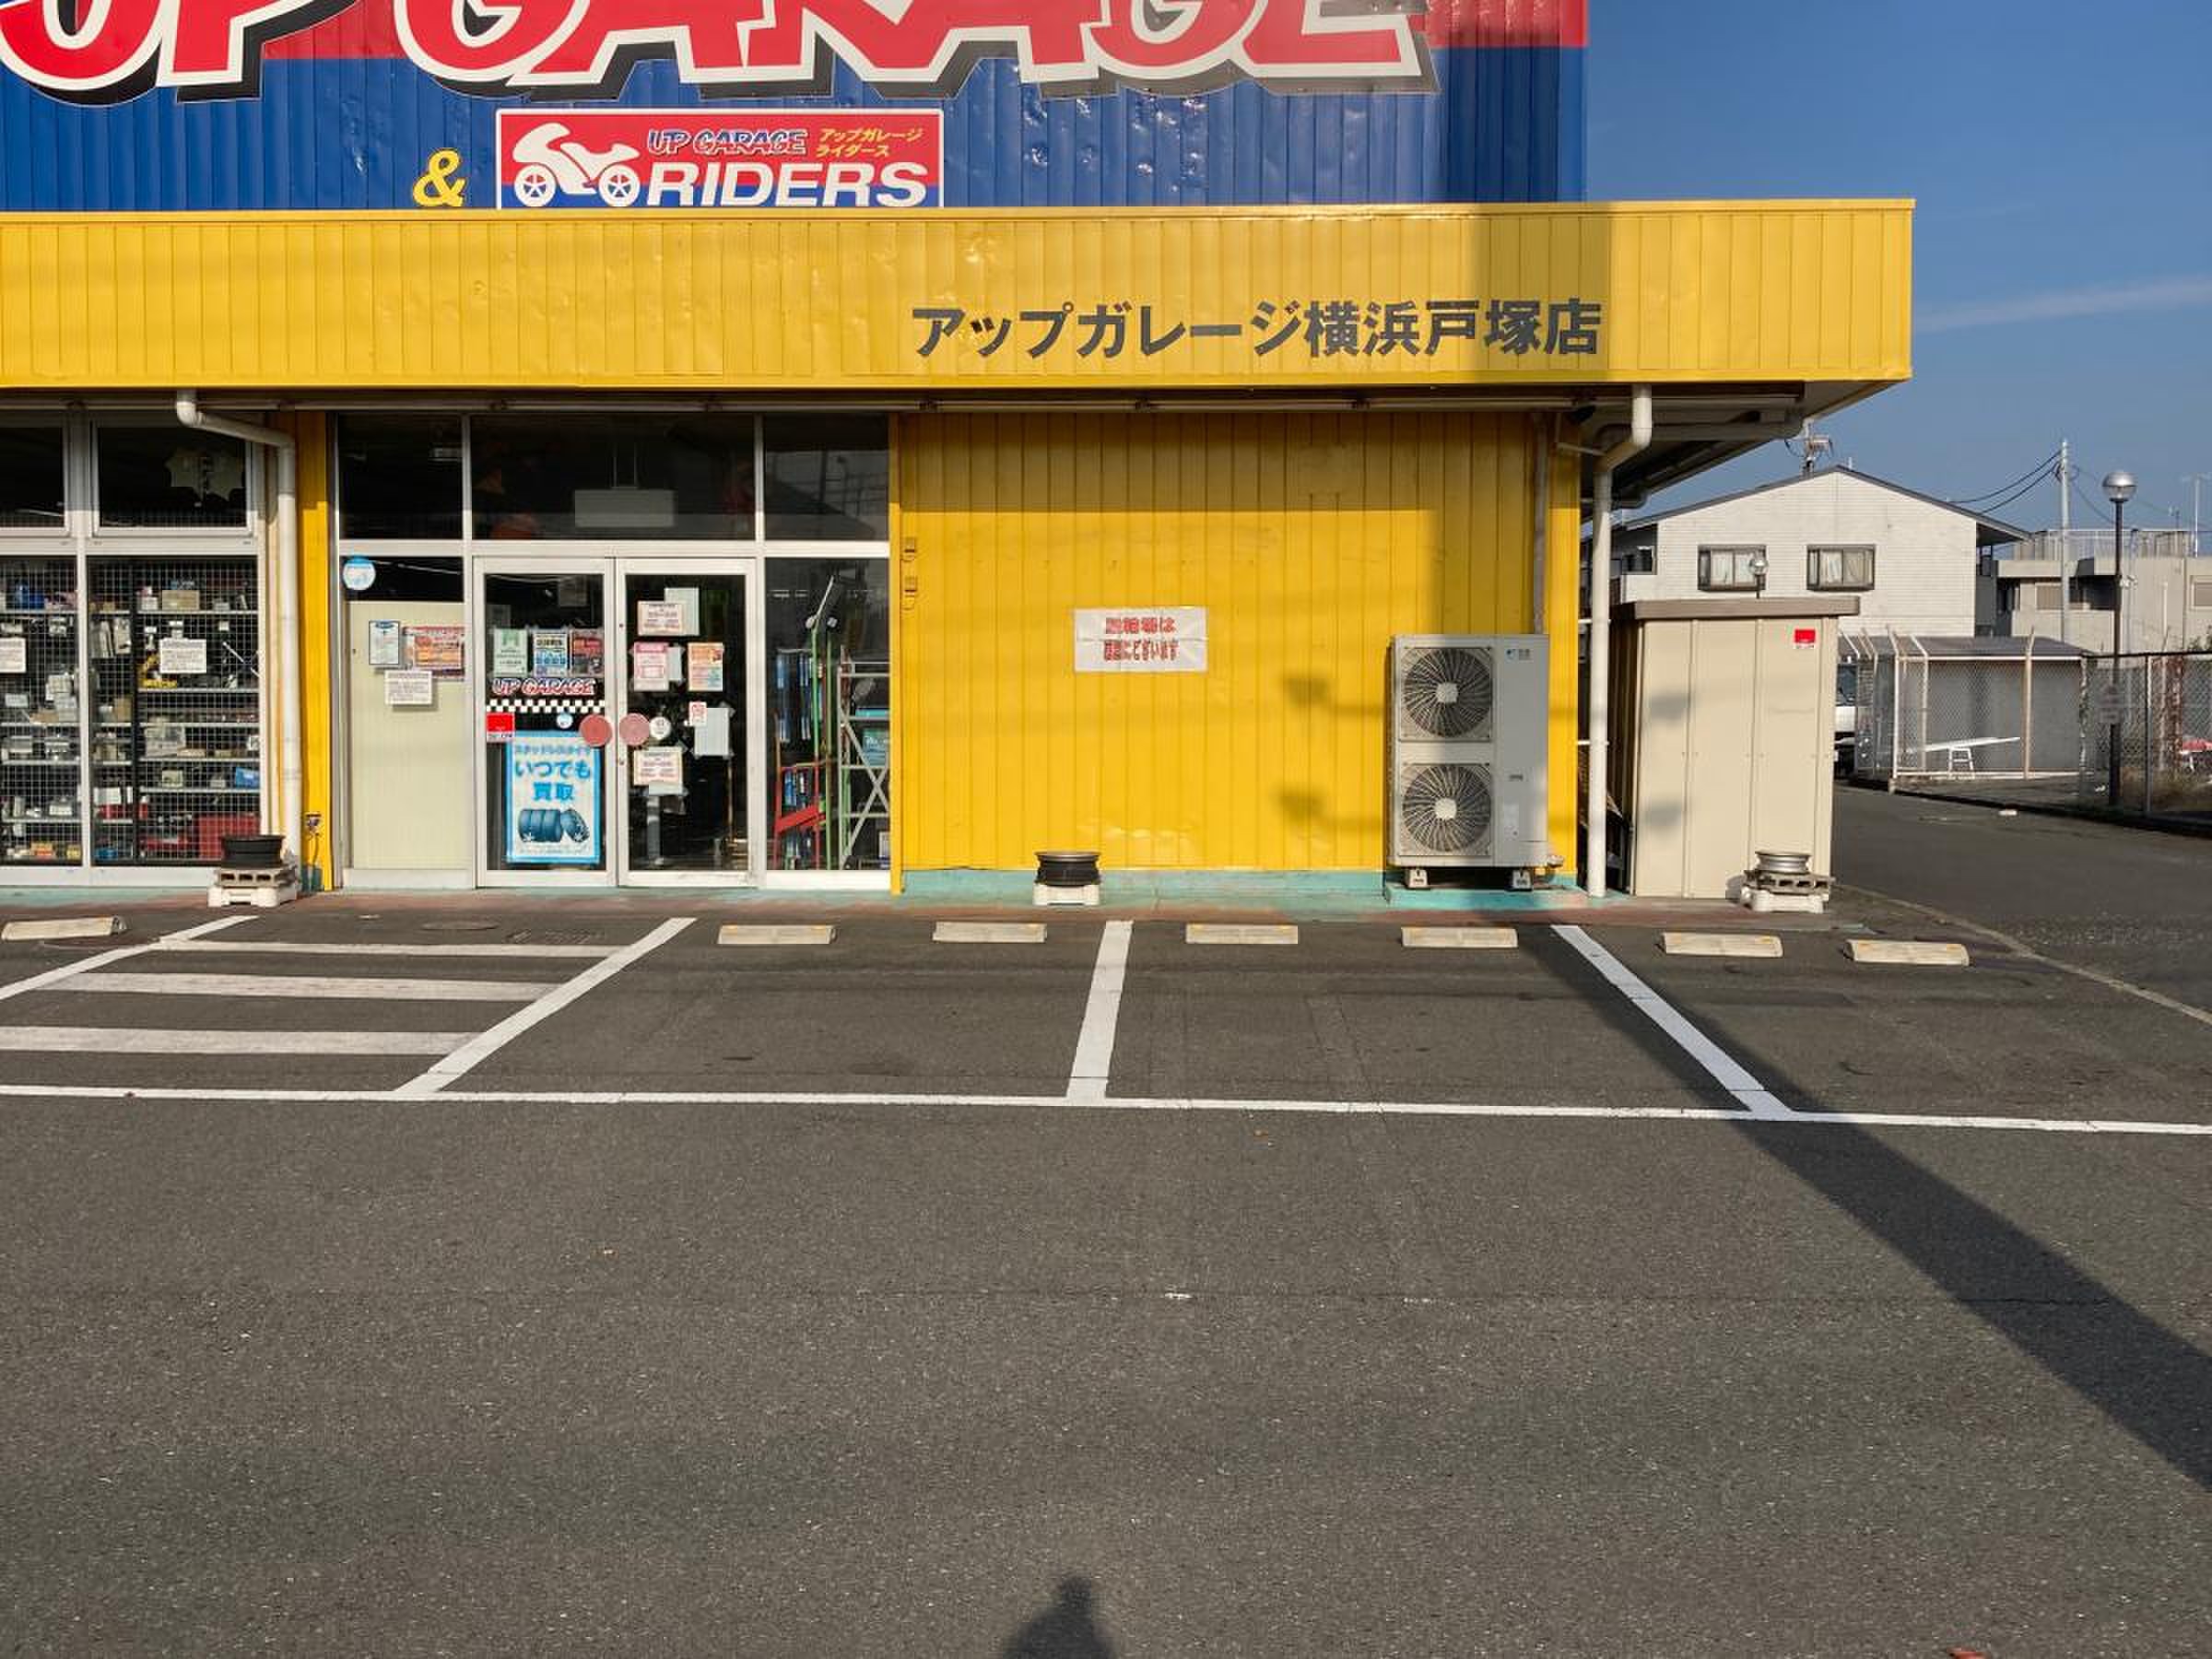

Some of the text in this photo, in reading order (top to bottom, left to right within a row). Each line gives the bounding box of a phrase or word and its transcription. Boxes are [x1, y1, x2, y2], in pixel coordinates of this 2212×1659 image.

[648, 127, 808, 156] UP GARAGE
[818, 127, 924, 142] アップガレージ
[816, 144, 890, 159] ライダース
[412, 149, 466, 207] &
[647, 161, 929, 207] RIDERS
[911, 298, 1602, 358] アップガレージ横浜戸塚店
[491, 677, 597, 696] UP GARAGE
[515, 759, 592, 780] いつでも
[533, 782, 574, 802] 買取
